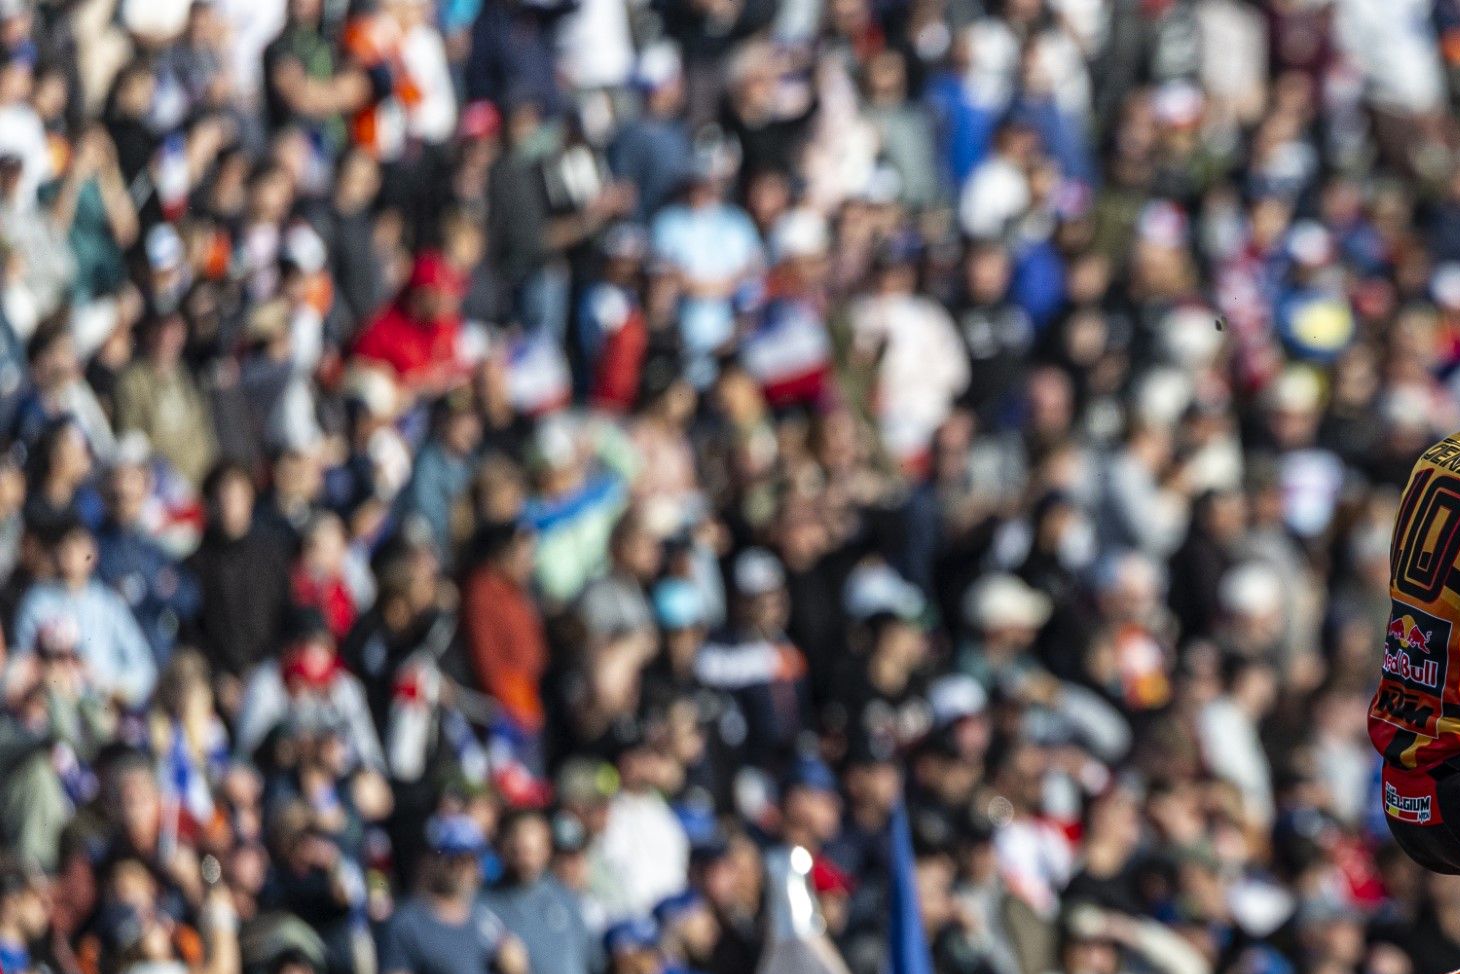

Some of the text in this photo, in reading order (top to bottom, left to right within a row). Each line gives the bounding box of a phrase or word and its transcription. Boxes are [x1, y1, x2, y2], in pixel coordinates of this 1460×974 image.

[1397, 649, 1439, 688] Bull
[1377, 686, 1434, 728] KTM
[1386, 790, 1431, 811] BELGIUM
